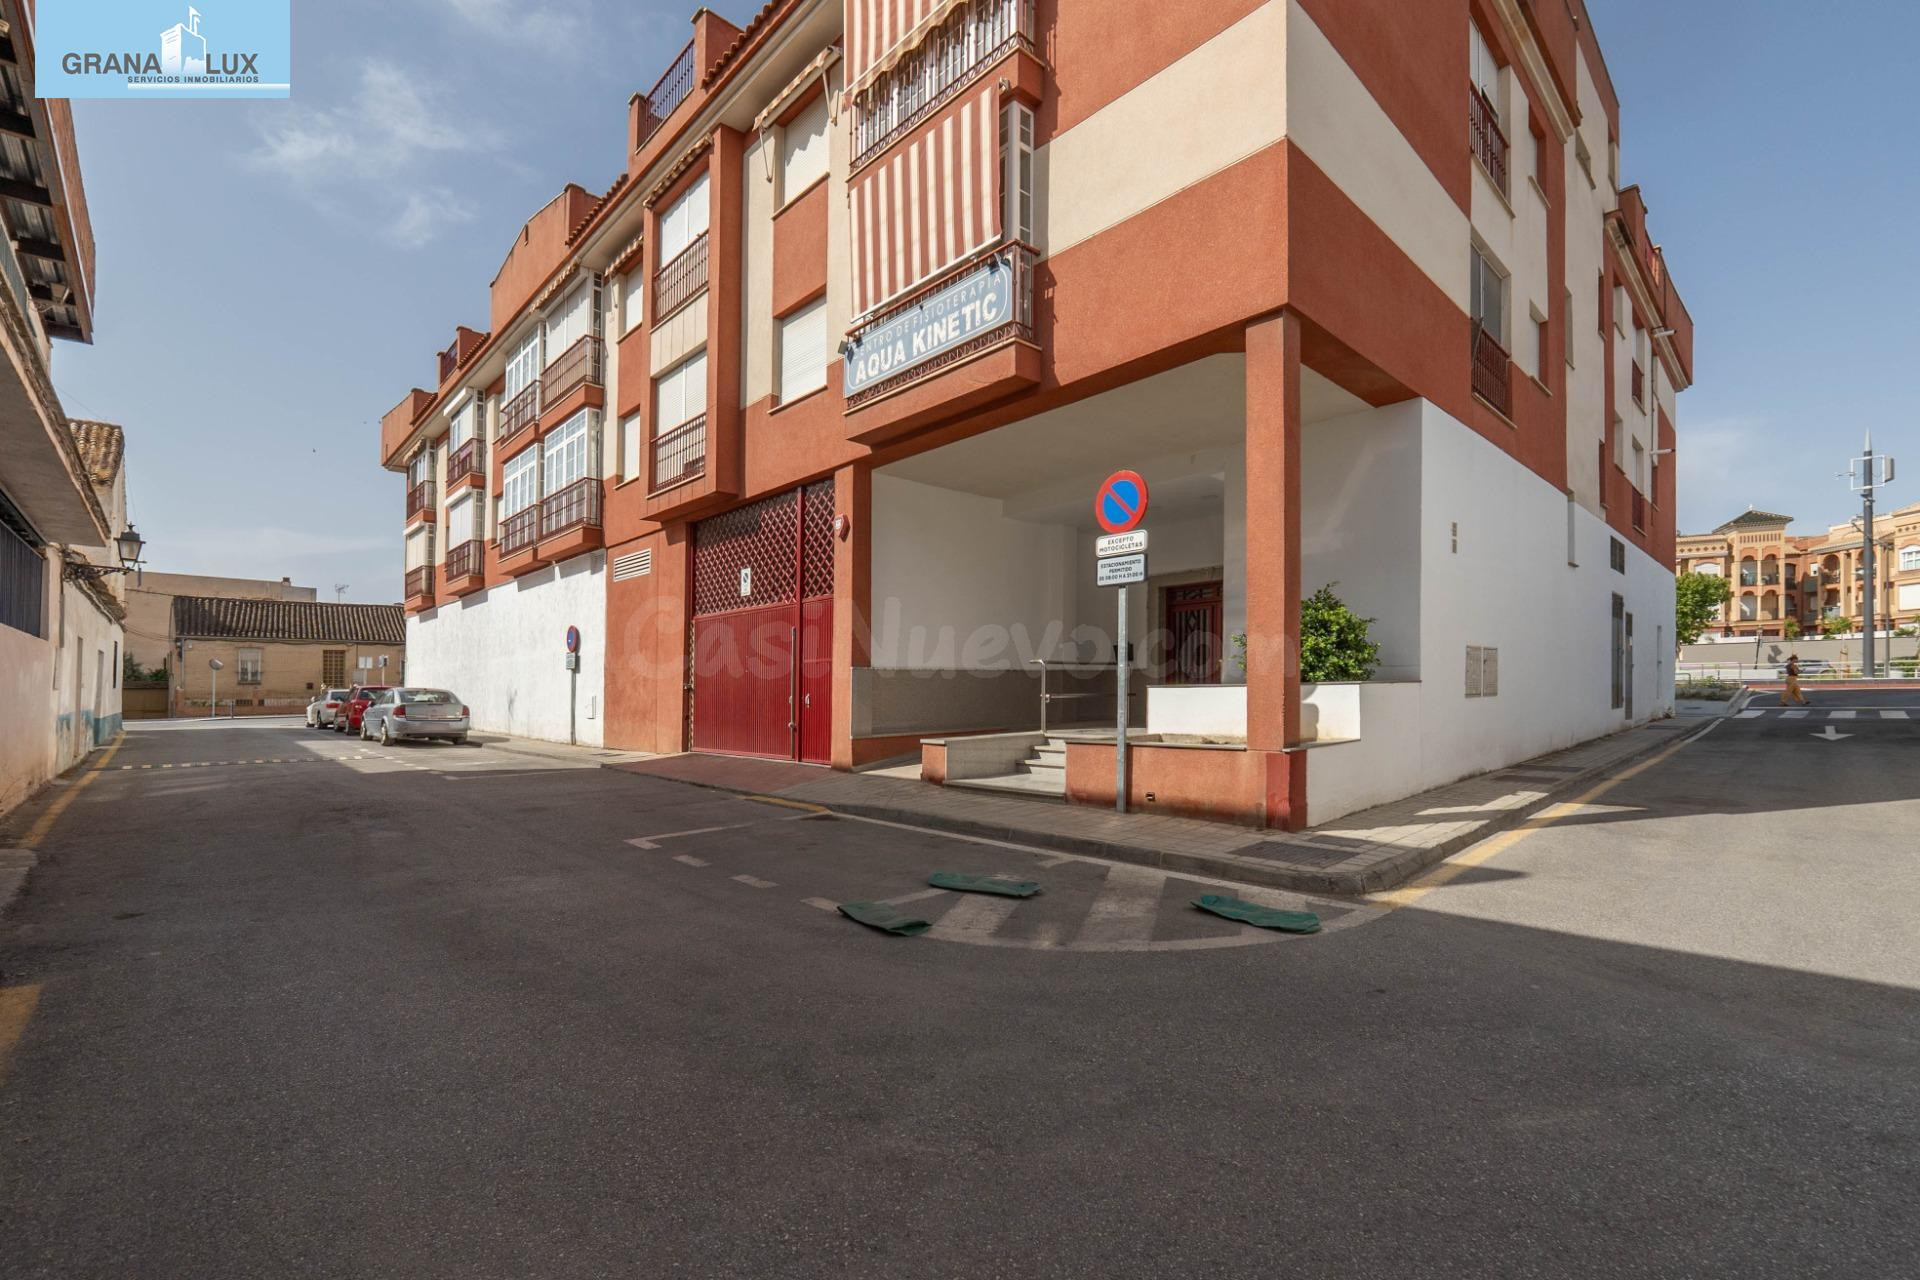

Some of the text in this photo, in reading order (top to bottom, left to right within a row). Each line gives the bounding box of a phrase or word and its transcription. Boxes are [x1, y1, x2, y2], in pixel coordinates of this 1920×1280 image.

[896, 322, 909, 337] DE
[913, 274, 1001, 329] FISIOTERAPIA
[856, 292, 997, 385] AQUA KINETIC
[1107, 536, 1134, 545] EXCEPTO
[1099, 542, 1143, 553] MOTOCICLETAS
[1100, 559, 1142, 569] ESTACIONAMIENTO
[1108, 566, 1133, 574] PERMITIDO
